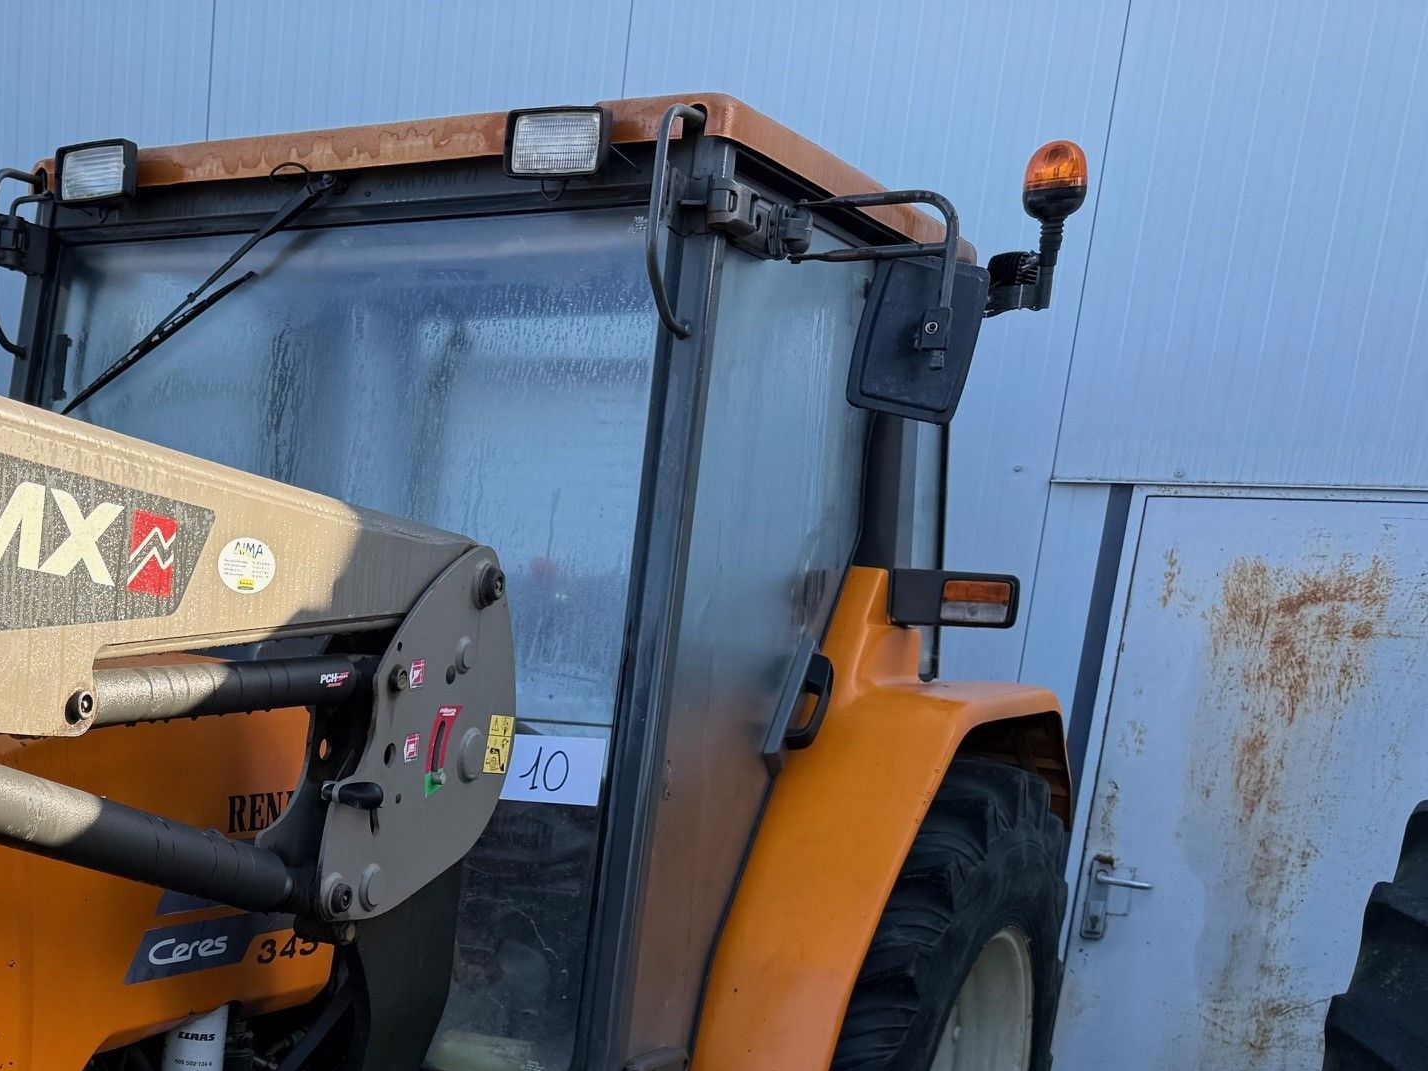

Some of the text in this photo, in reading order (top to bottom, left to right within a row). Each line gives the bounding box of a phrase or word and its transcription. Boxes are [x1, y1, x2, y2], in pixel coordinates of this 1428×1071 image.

[320, 672, 338, 684] PCH
[519, 746, 570, 792] 10
[227, 790, 295, 833] REN
[148, 934, 319, 966] Ceres 345
[177, 1031, 216, 1042] CLAAS
